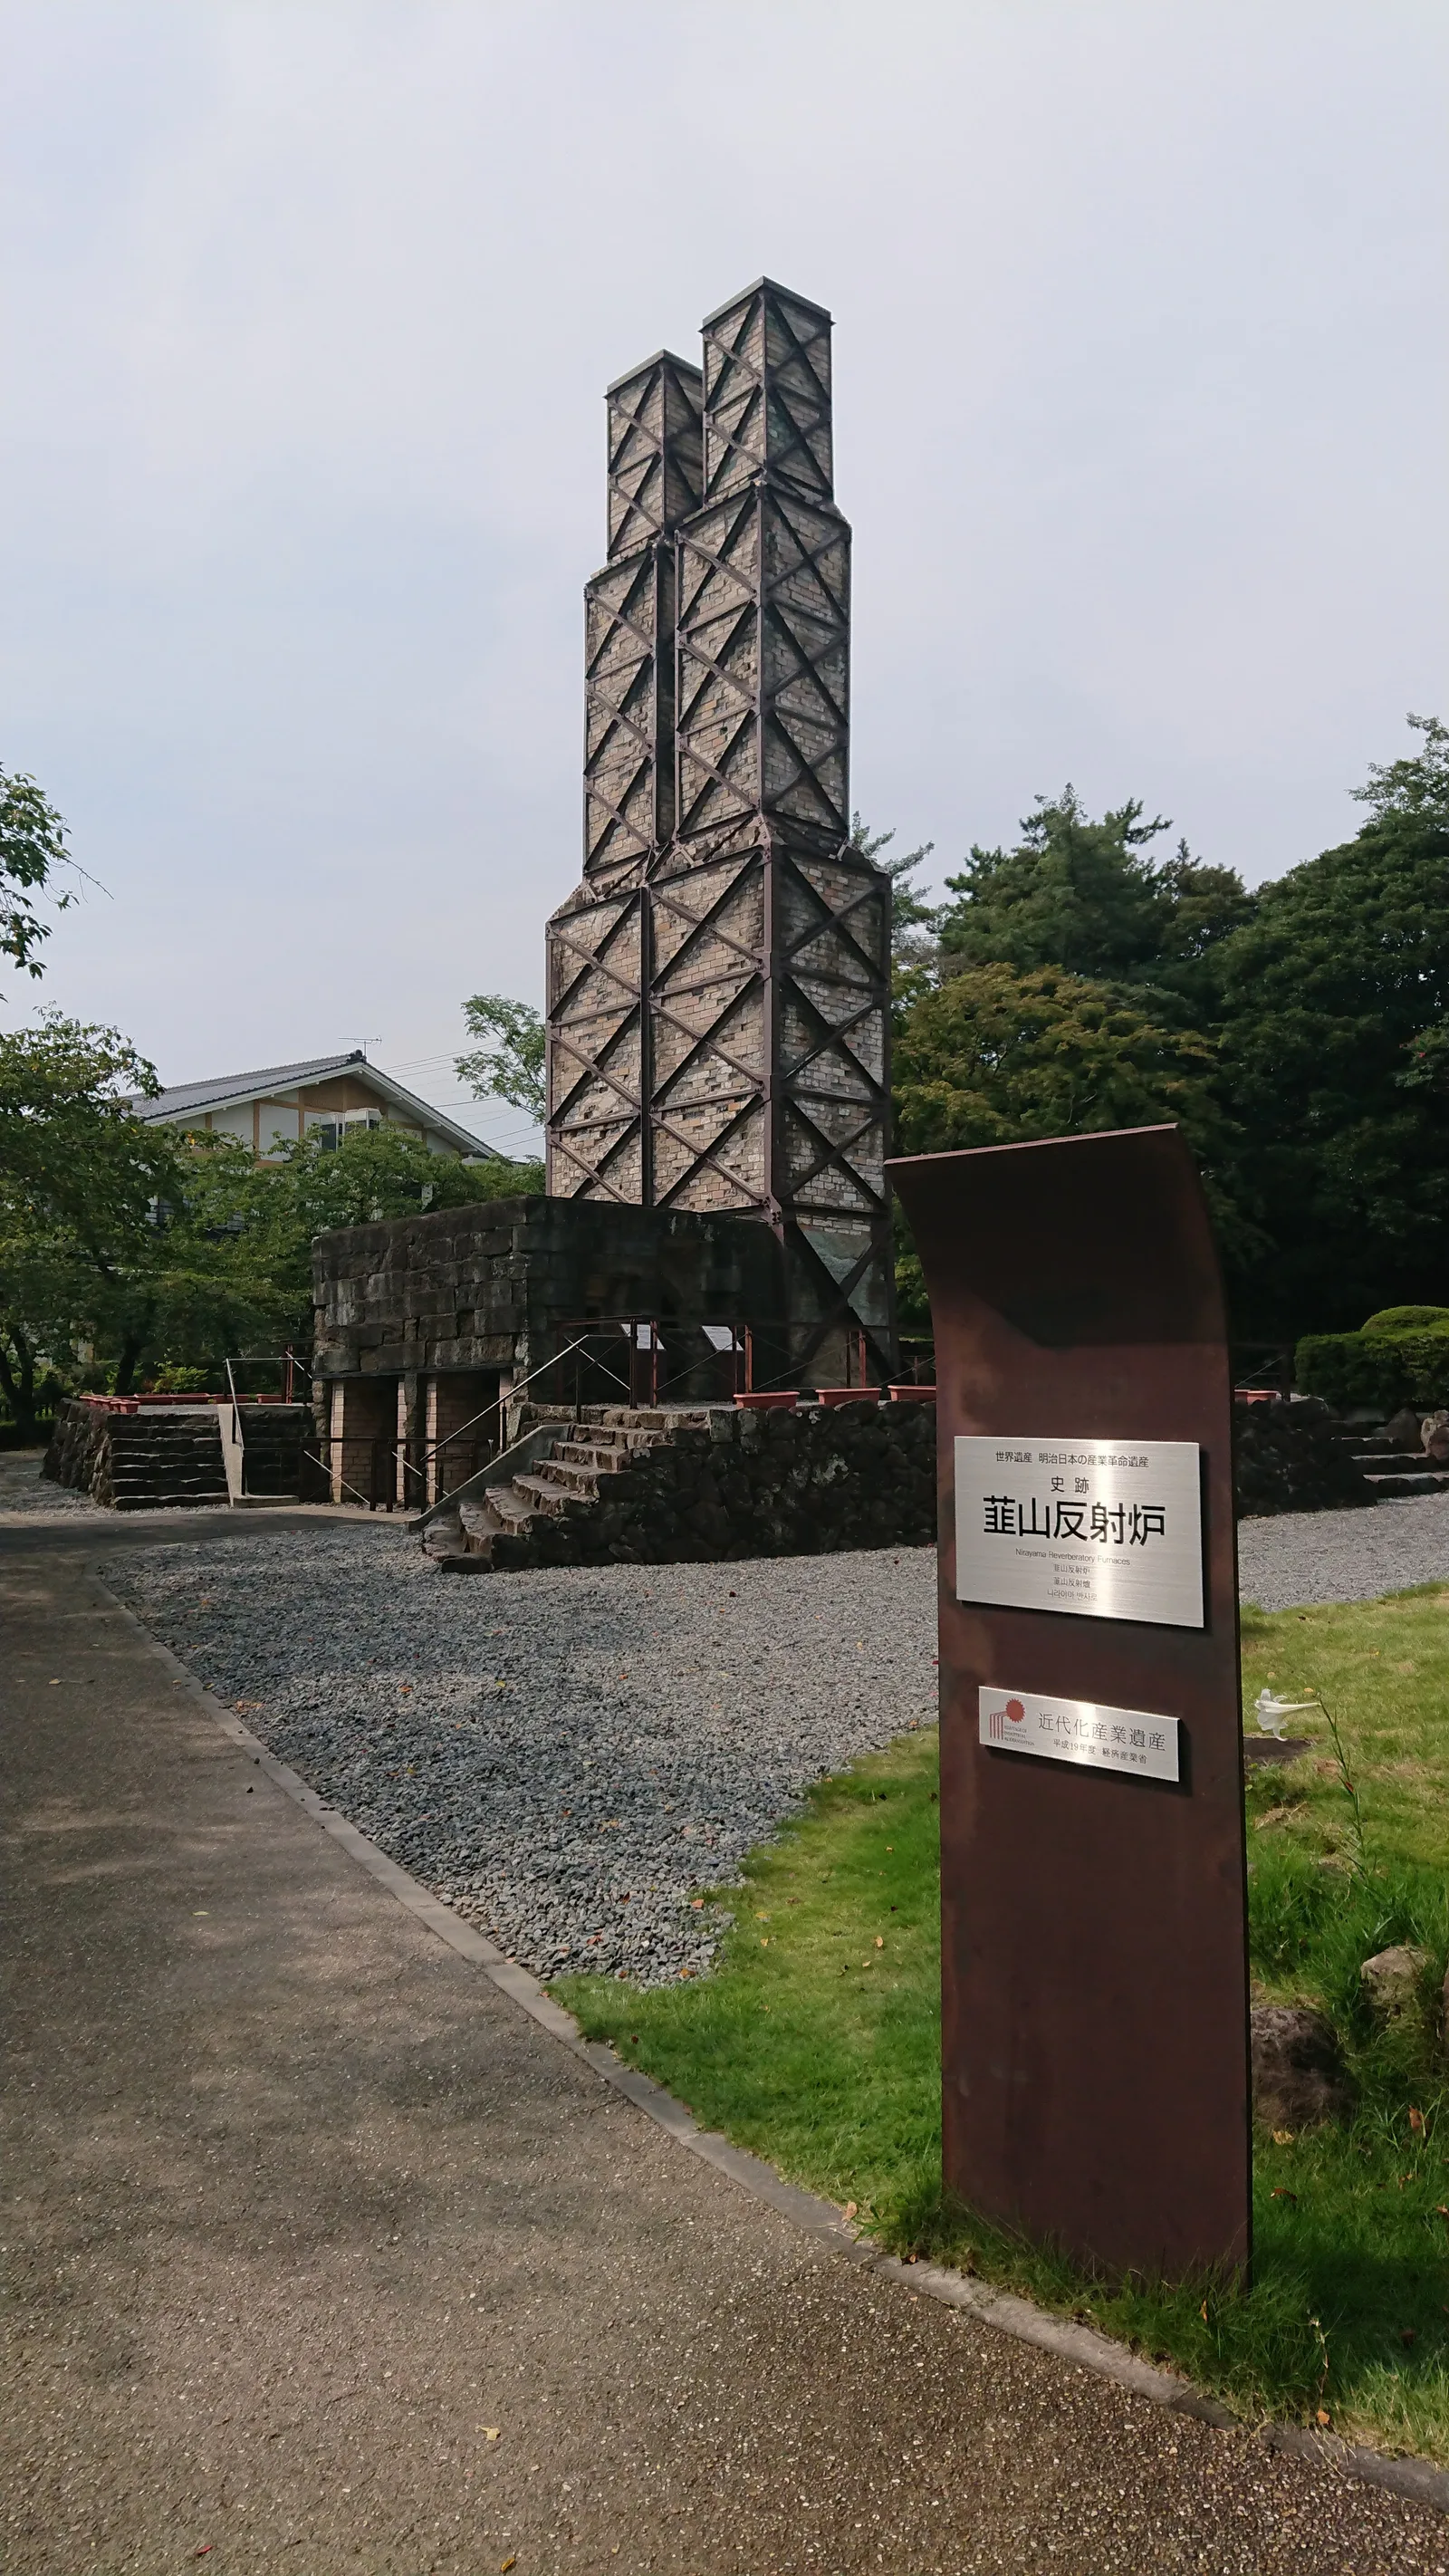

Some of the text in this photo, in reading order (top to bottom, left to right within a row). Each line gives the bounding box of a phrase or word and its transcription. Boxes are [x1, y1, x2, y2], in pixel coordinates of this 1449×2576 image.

[995, 1451, 1149, 1467] 世界遺産 明治日本の産業革命遺産
[984, 1495, 1166, 1546] 韮山反射炉
[1015, 1548, 1131, 1565] Nirayama Reverberatory Furnaces
[1038, 1712, 1166, 1752] 近代化産業遺産
[1053, 1738, 1097, 1755] 平成19年度
[1102, 1746, 1148, 1764] 経済産業省
